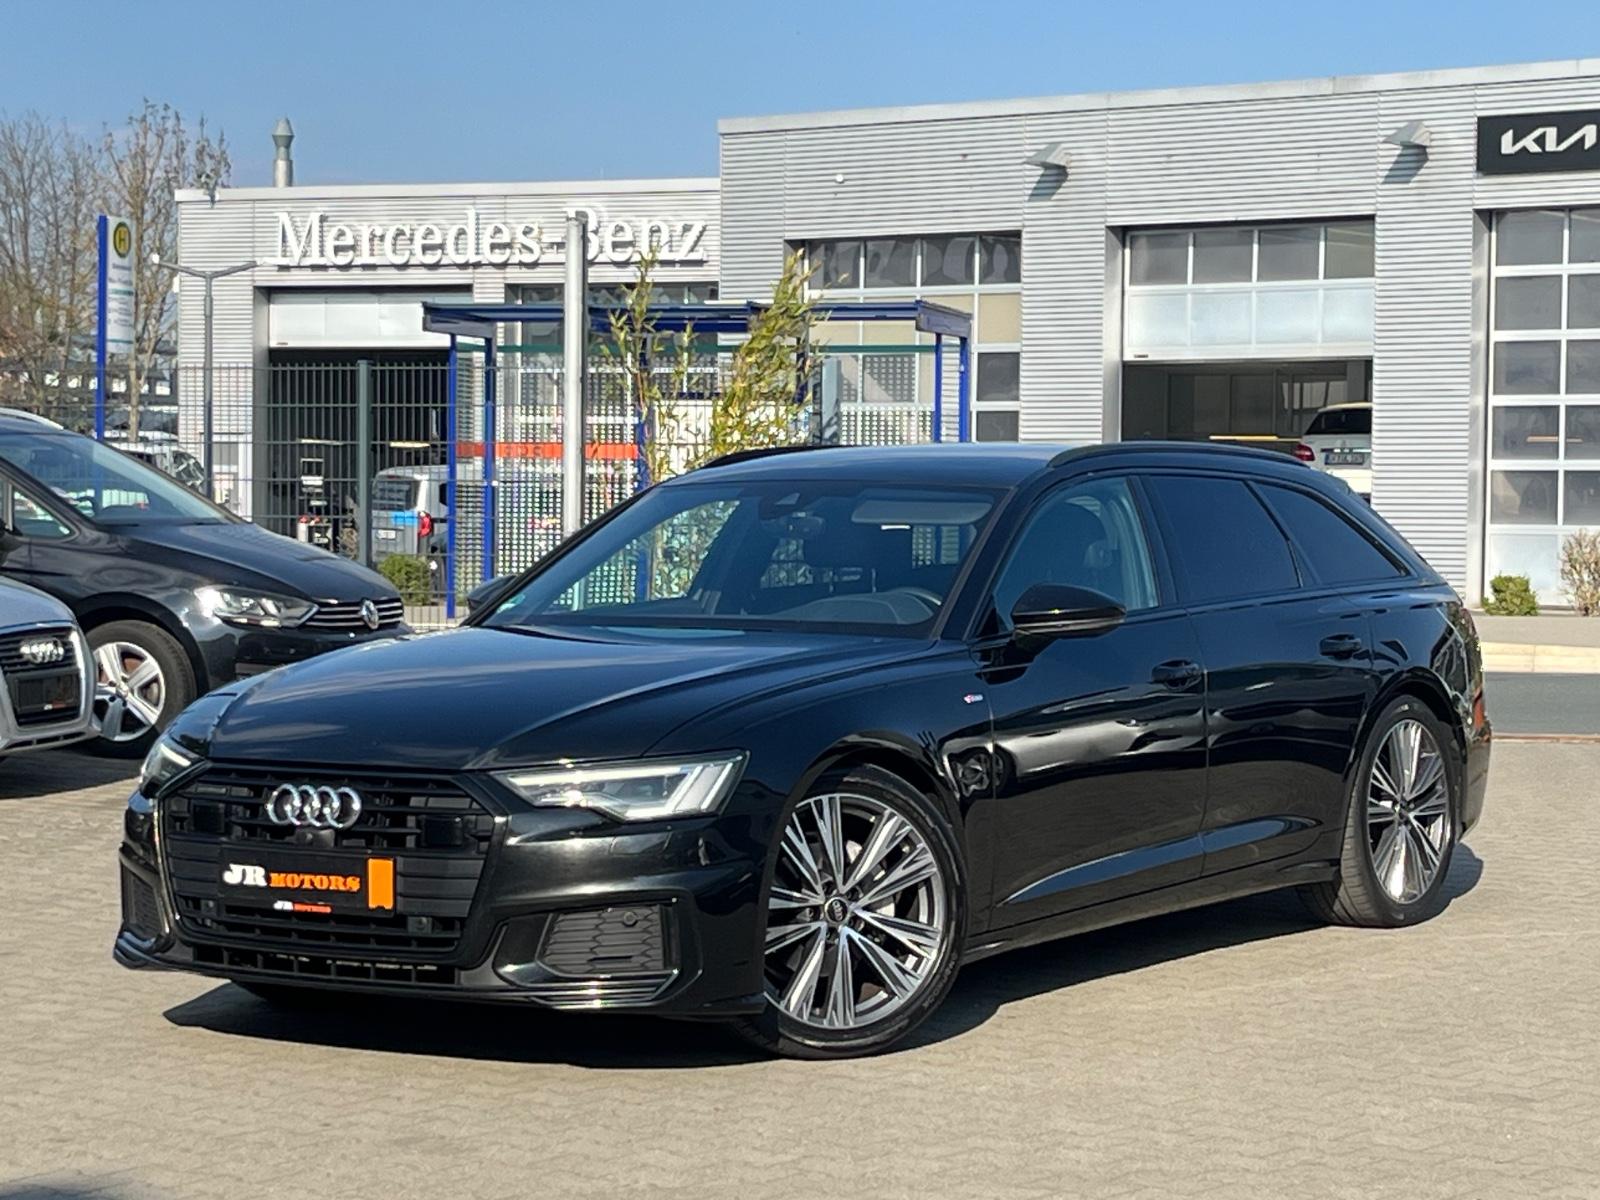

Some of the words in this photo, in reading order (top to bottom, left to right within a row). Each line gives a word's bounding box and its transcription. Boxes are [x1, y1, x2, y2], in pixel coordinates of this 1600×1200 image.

[1501, 124, 1597, 155] KIA
[222, 863, 268, 887] JR
[268, 872, 361, 893] MOTORS
